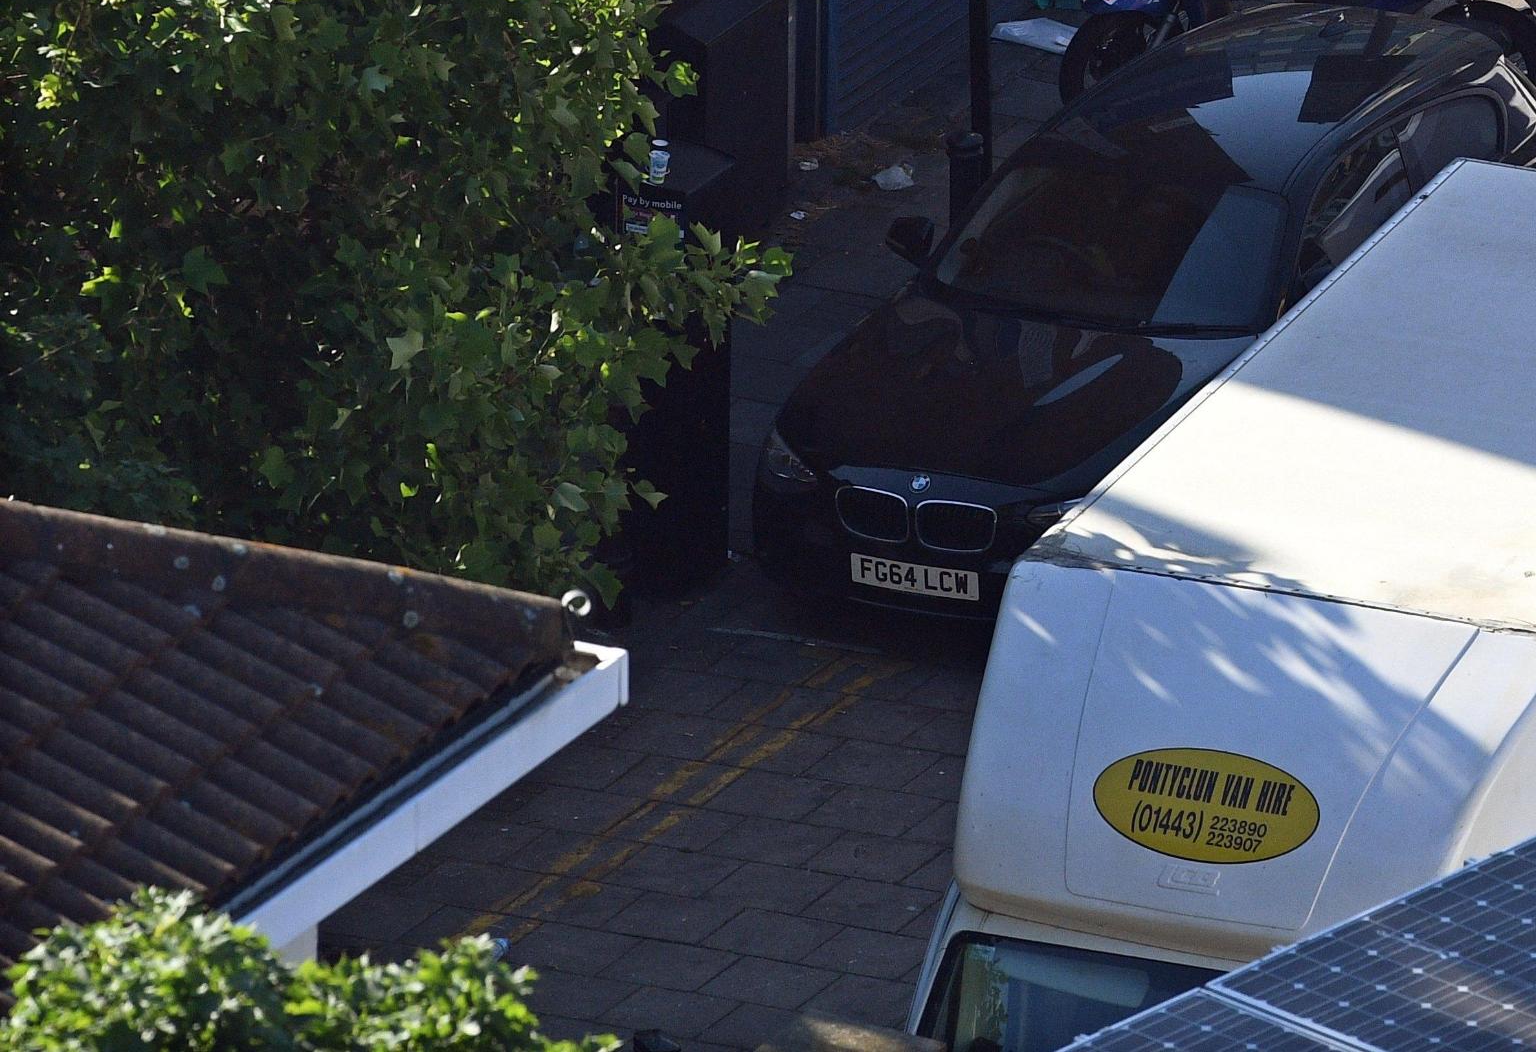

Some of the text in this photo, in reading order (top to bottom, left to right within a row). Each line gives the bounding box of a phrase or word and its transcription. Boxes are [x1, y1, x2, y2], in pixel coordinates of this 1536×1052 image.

[639, 197, 649, 207] by
[652, 201, 682, 209] mobile
[860, 558, 968, 595] FG64 LCW
[1127, 758, 1295, 816] PONTYCLUN VAN HIRE
[1131, 800, 1268, 843] (01443) 223890
[1205, 832, 1262, 853] 223907
